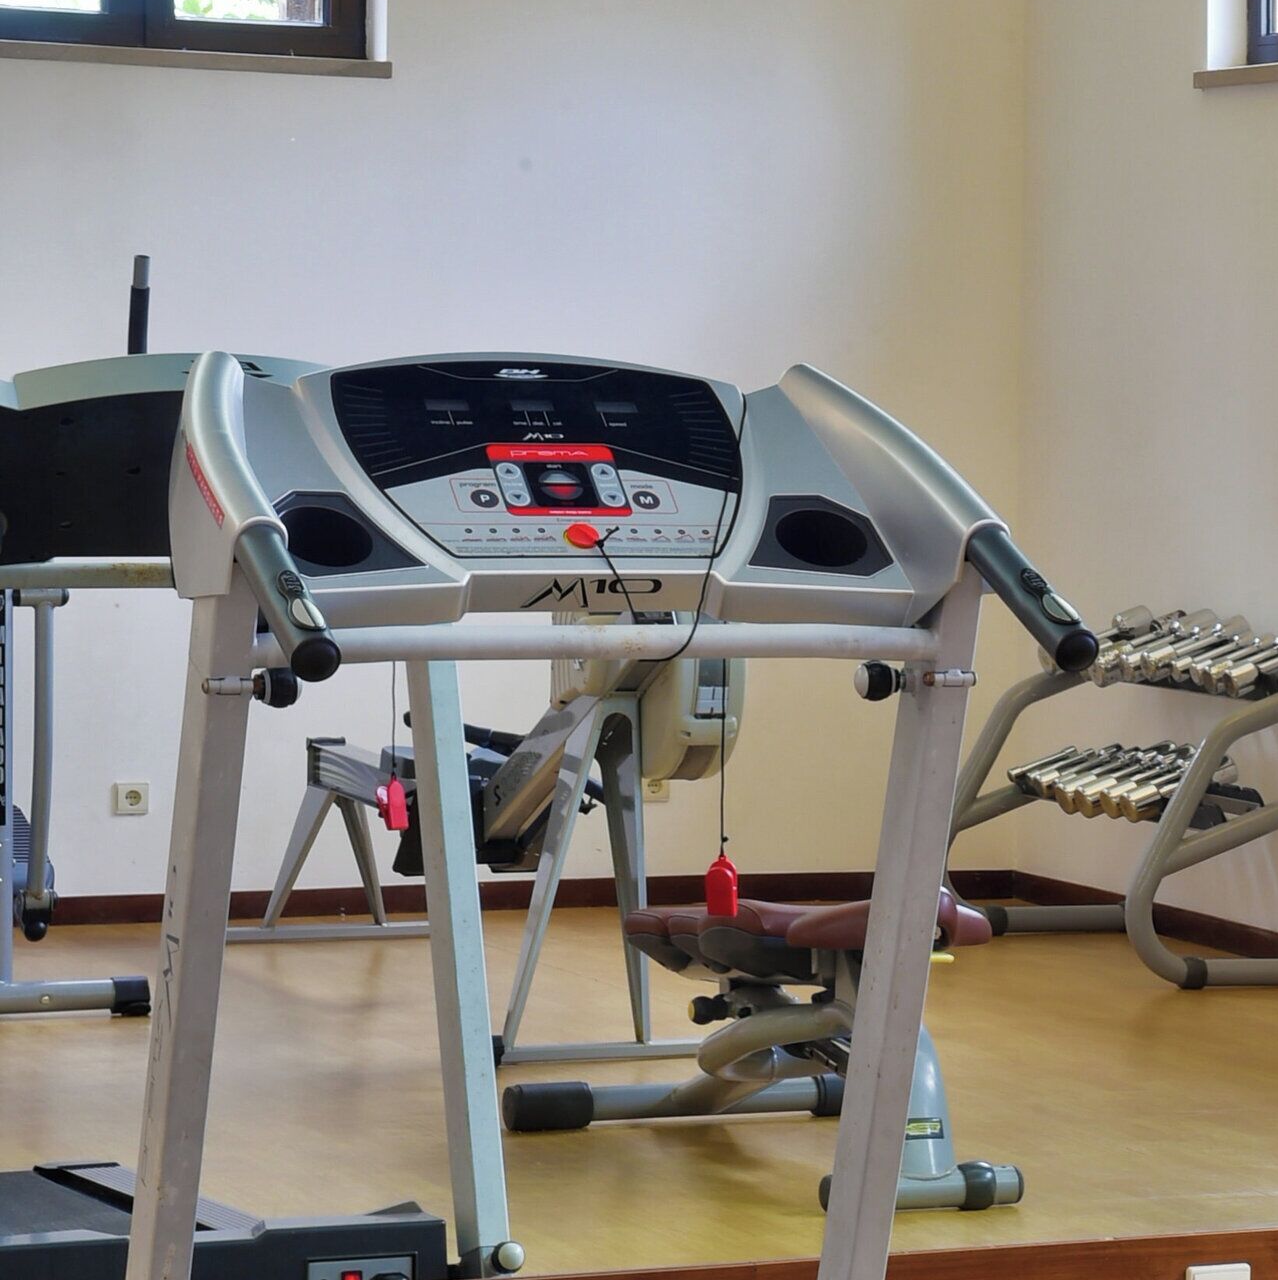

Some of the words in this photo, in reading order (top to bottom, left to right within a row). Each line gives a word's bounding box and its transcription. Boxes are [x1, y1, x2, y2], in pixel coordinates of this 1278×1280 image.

[480, 494, 490, 503] P
[639, 495, 654, 505] M
[520, 577, 662, 608] M10
